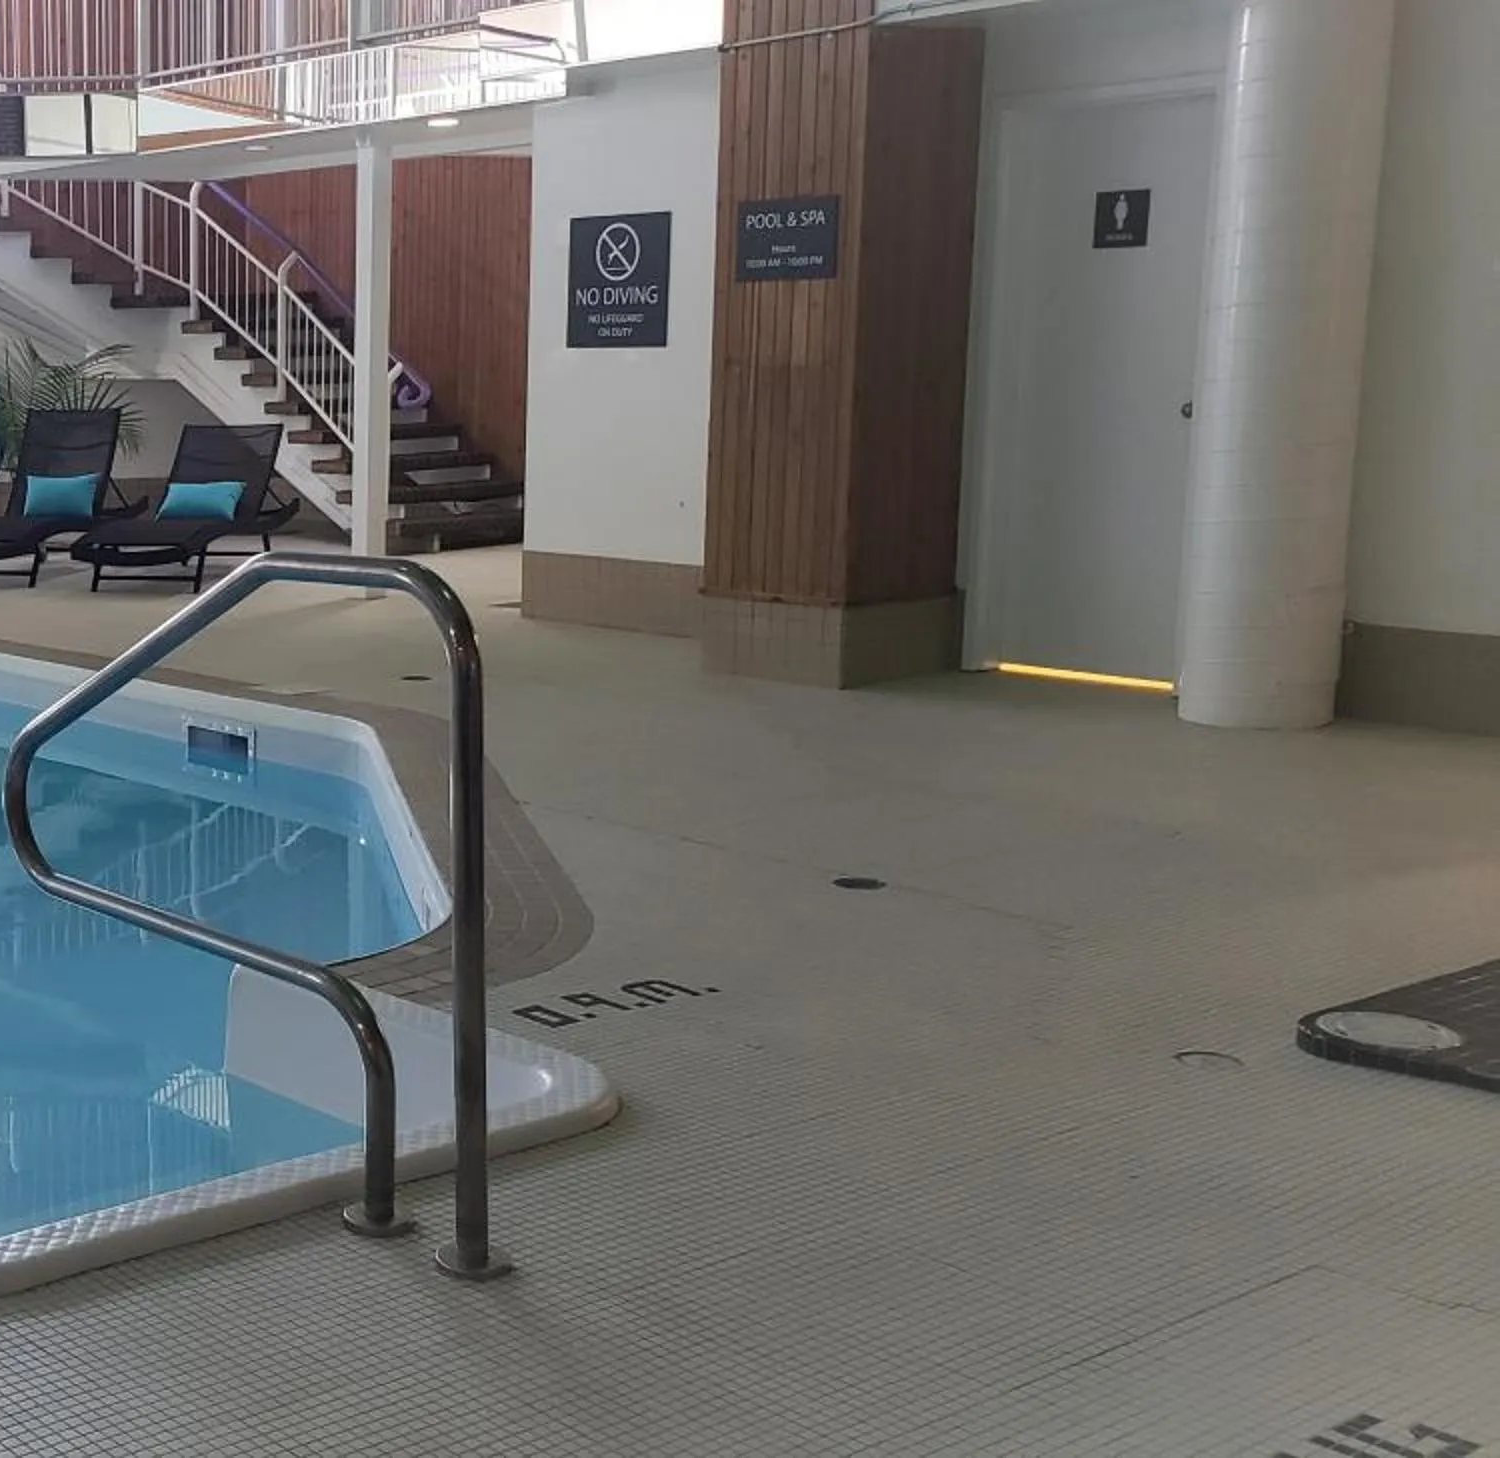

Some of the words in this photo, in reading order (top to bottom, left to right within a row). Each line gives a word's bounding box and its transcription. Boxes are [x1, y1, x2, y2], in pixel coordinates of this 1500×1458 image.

[745, 213, 784, 229] POOL
[787, 211, 797, 227] &
[800, 209, 826, 227] SPA
[768, 257, 780, 267] AM
[810, 255, 823, 265] PM
[575, 287, 600, 305] NO
[603, 286, 659, 305] DIVING
[588, 313, 600, 324] NO
[602, 312, 644, 323] LIFEGUARD
[598, 328, 610, 337] ON
[612, 327, 633, 337] DUTY
